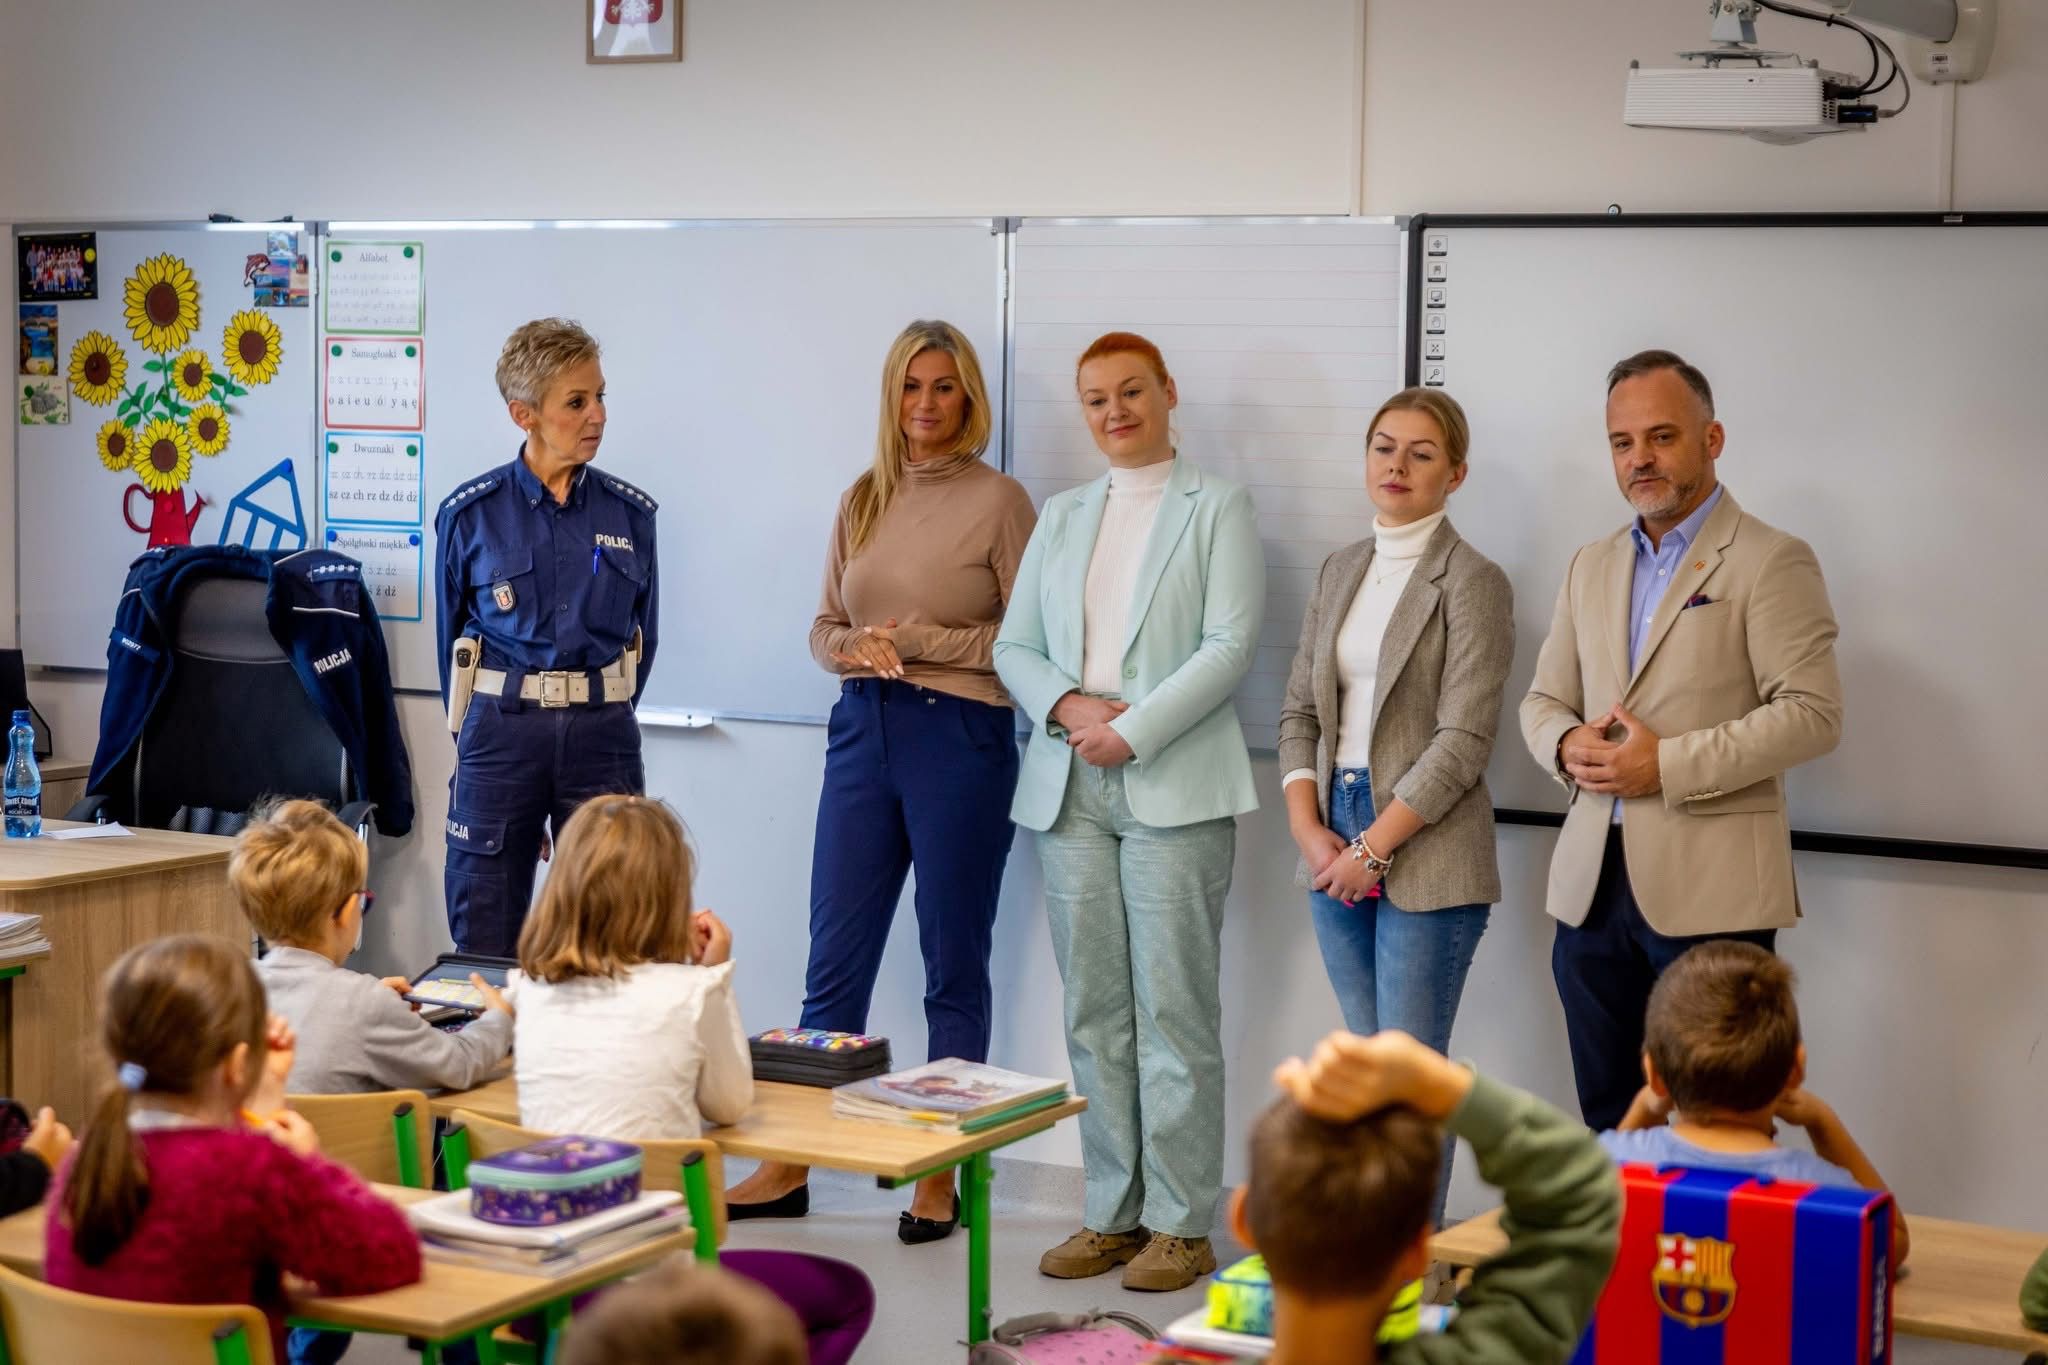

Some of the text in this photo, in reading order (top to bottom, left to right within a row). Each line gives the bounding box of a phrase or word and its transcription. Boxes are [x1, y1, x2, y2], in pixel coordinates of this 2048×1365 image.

[360, 252, 388, 262] Alfabet
[351, 347, 397, 360] Samogłoski
[328, 396, 335, 405] o
[337, 397, 344, 405] a
[354, 397, 361, 405] e
[363, 397, 371, 405] u
[377, 393, 384, 405] ó
[391, 397, 398, 409] y
[401, 397, 408, 409] ą
[353, 442, 394, 454] Dwuznaki
[328, 490, 339, 499] sz
[341, 491, 351, 500] cz
[353, 488, 365, 500] ch
[367, 492, 377, 501] rz
[379, 490, 391, 501] dz
[337, 537, 411, 550] Spółgłoski miękkie
[595, 533, 634, 551] POLICJ
[313, 647, 352, 674] POLICJA
[447, 818, 468, 840] LICJA
